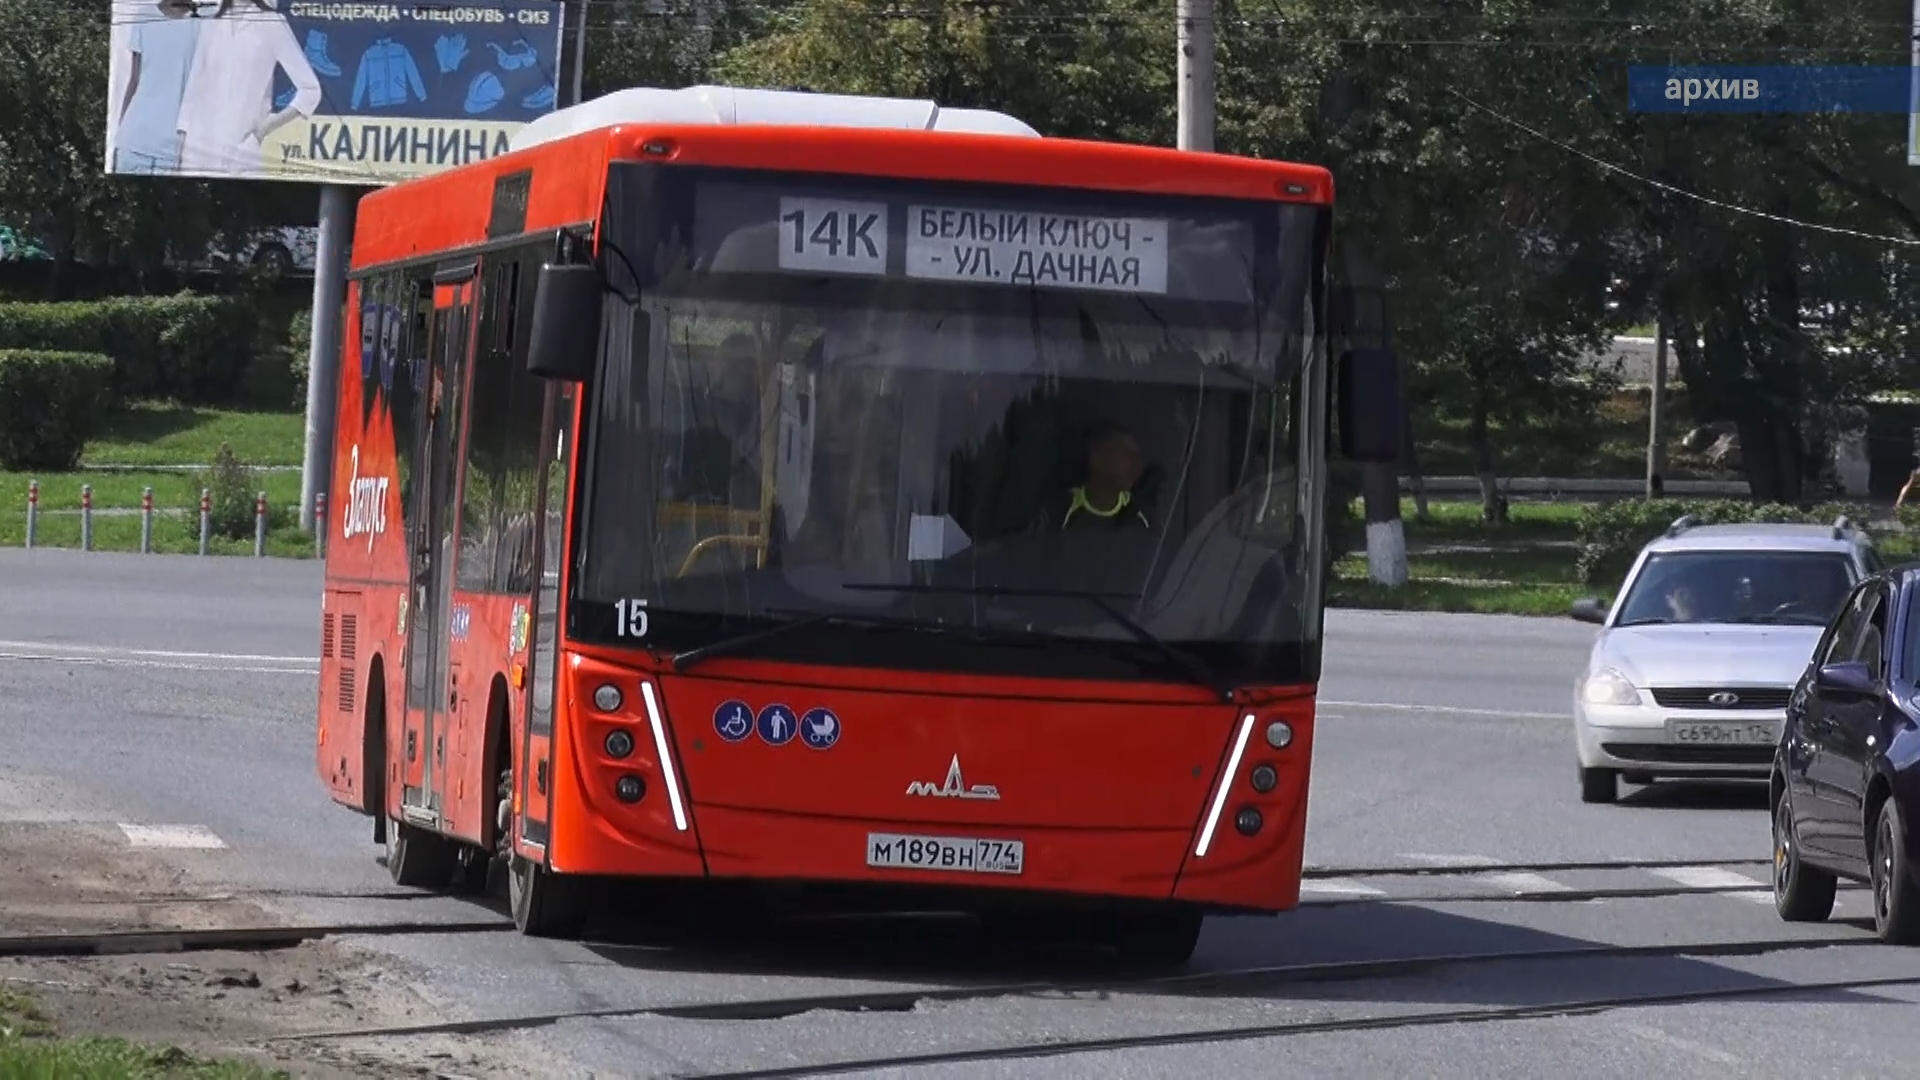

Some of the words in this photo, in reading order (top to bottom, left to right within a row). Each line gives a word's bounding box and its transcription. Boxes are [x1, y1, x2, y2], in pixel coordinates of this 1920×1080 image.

[289, 2, 400, 22] СПЕЦОДЕЖДА
[412, 6, 505, 24] СПЕЦОБУВЬ
[517, 9, 550, 24] СИЗ
[281, 142, 307, 163] ул.
[309, 122, 510, 166] КАЛИНИНА
[783, 210, 879, 258] 14К
[1038, 217, 1131, 251] КЛЮЧ
[953, 245, 1001, 277] УЛ.
[1011, 250, 1140, 287] ДАЧНАЯ
[615, 599, 648, 637] 15
[979, 841, 1016, 864] 774
